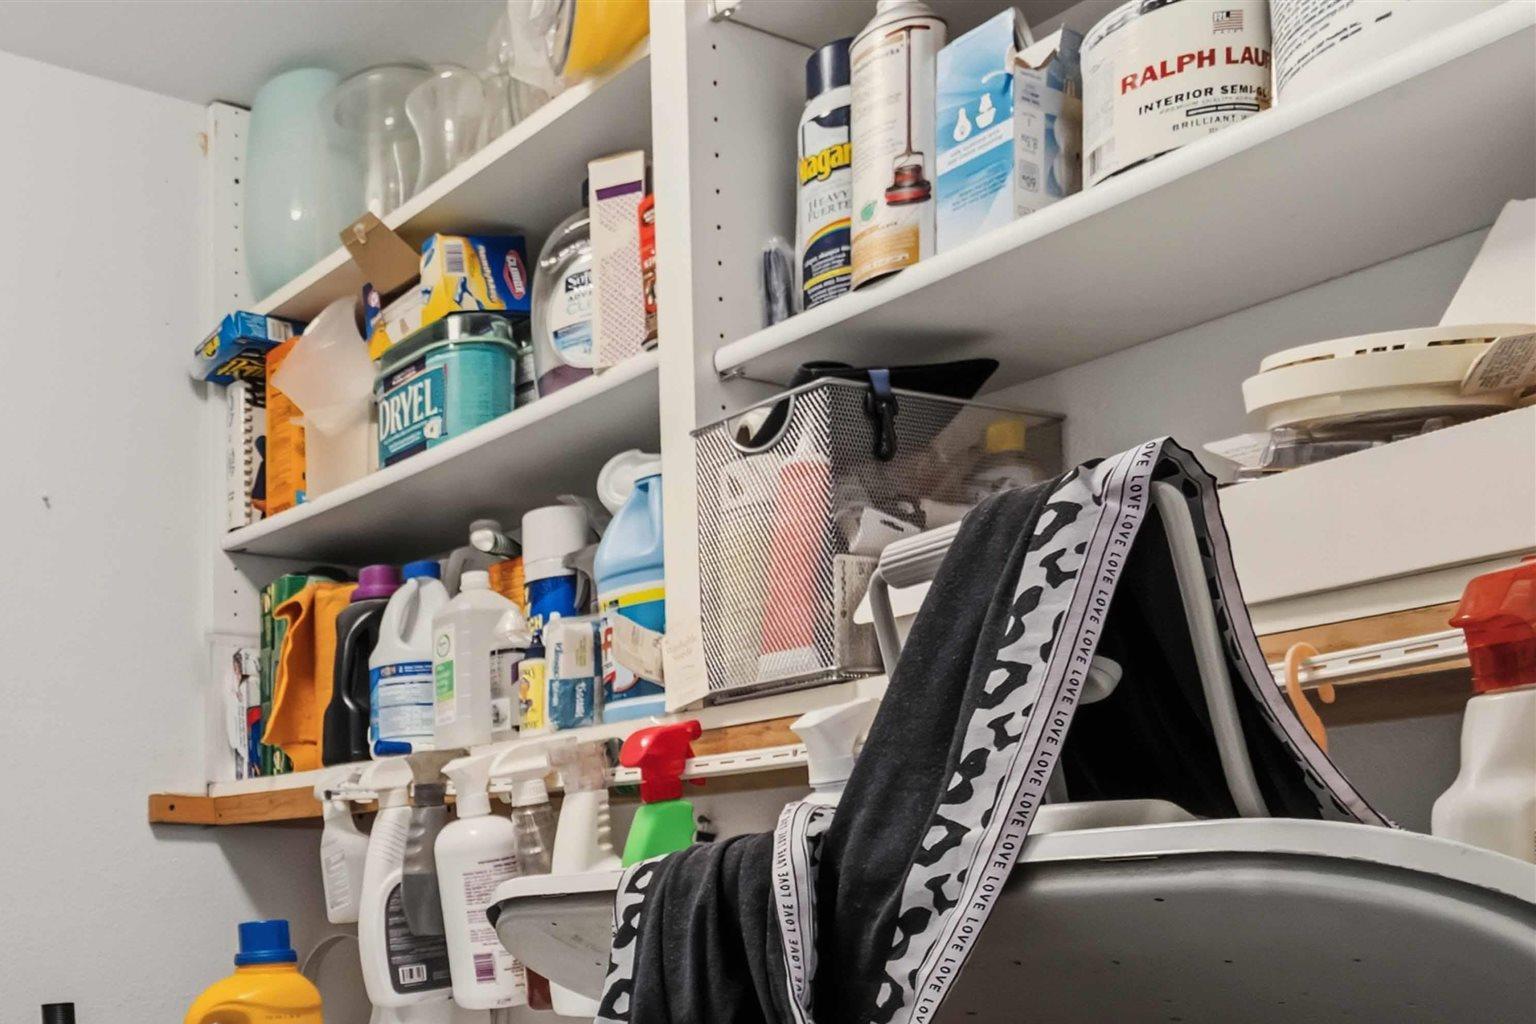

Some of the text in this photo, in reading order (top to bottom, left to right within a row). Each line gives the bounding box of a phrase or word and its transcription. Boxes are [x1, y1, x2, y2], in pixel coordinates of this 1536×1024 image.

[1121, 48, 1216, 95] RALPH
[1138, 86, 1214, 116] INTERIOR
[1172, 114, 1236, 132] BRILLIANT
[379, 378, 438, 442] DRYEL
[1136, 441, 1157, 467] OVE
[1127, 475, 1144, 511] LOVE
[1114, 514, 1137, 547] LOVE
[1103, 552, 1121, 585] LOVE
[1090, 589, 1109, 625] LOVE
[1076, 629, 1096, 665] LOVE
[1062, 669, 1082, 705] LOVE
[1047, 710, 1069, 746] LOVE
[1029, 751, 1053, 787] LOVE
[1011, 792, 1036, 828] LOVE
[993, 833, 1019, 870] LOVE
[778, 872, 792, 898] LOVE
[973, 875, 1000, 911] LOVE
[782, 903, 796, 933] LOVE
[952, 916, 979, 952] LOVE
[788, 938, 802, 970] LOVE
[929, 957, 956, 993] LOVE
